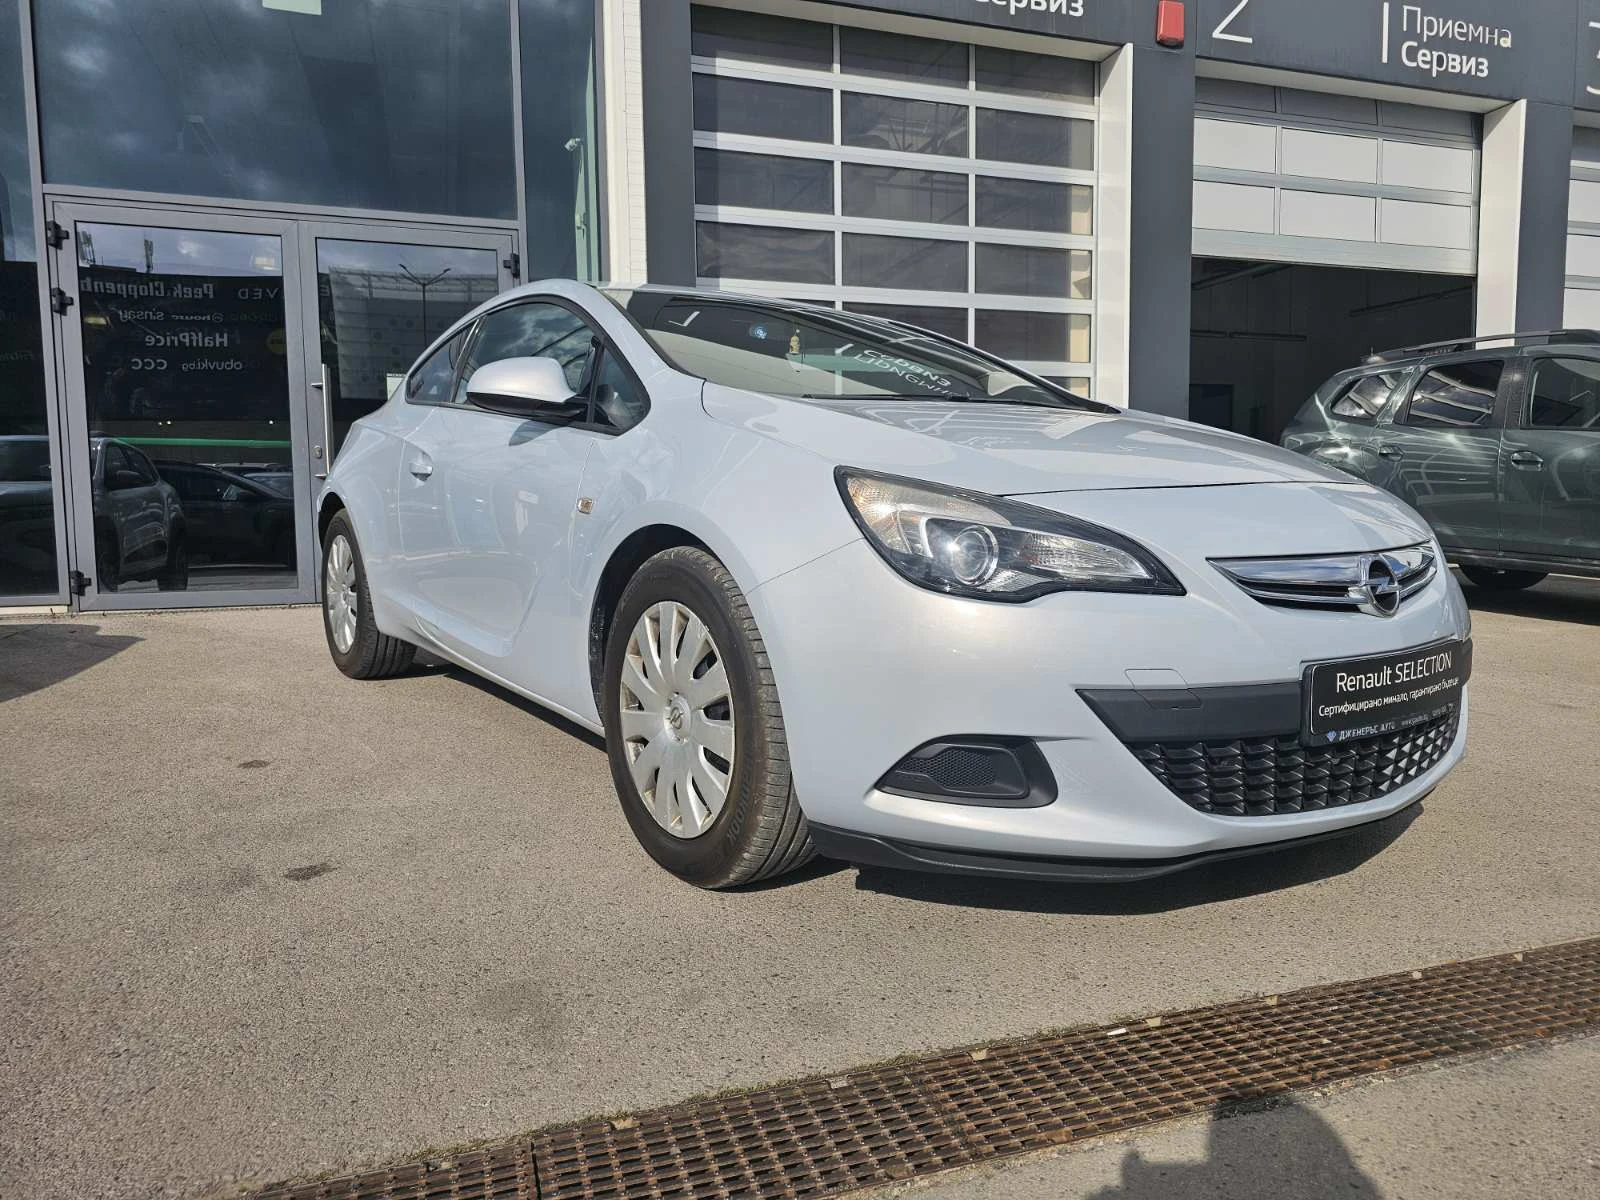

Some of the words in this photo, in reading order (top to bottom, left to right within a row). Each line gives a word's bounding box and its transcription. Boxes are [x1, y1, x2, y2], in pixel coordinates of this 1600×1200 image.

[1402, 5, 1512, 48] Приемна
[1401, 41, 1489, 77] Сервиз
[1336, 665, 1392, 694] Renault
[1394, 650, 1452, 684] SELECTION
[1318, 697, 1382, 718] Сертифицирано
